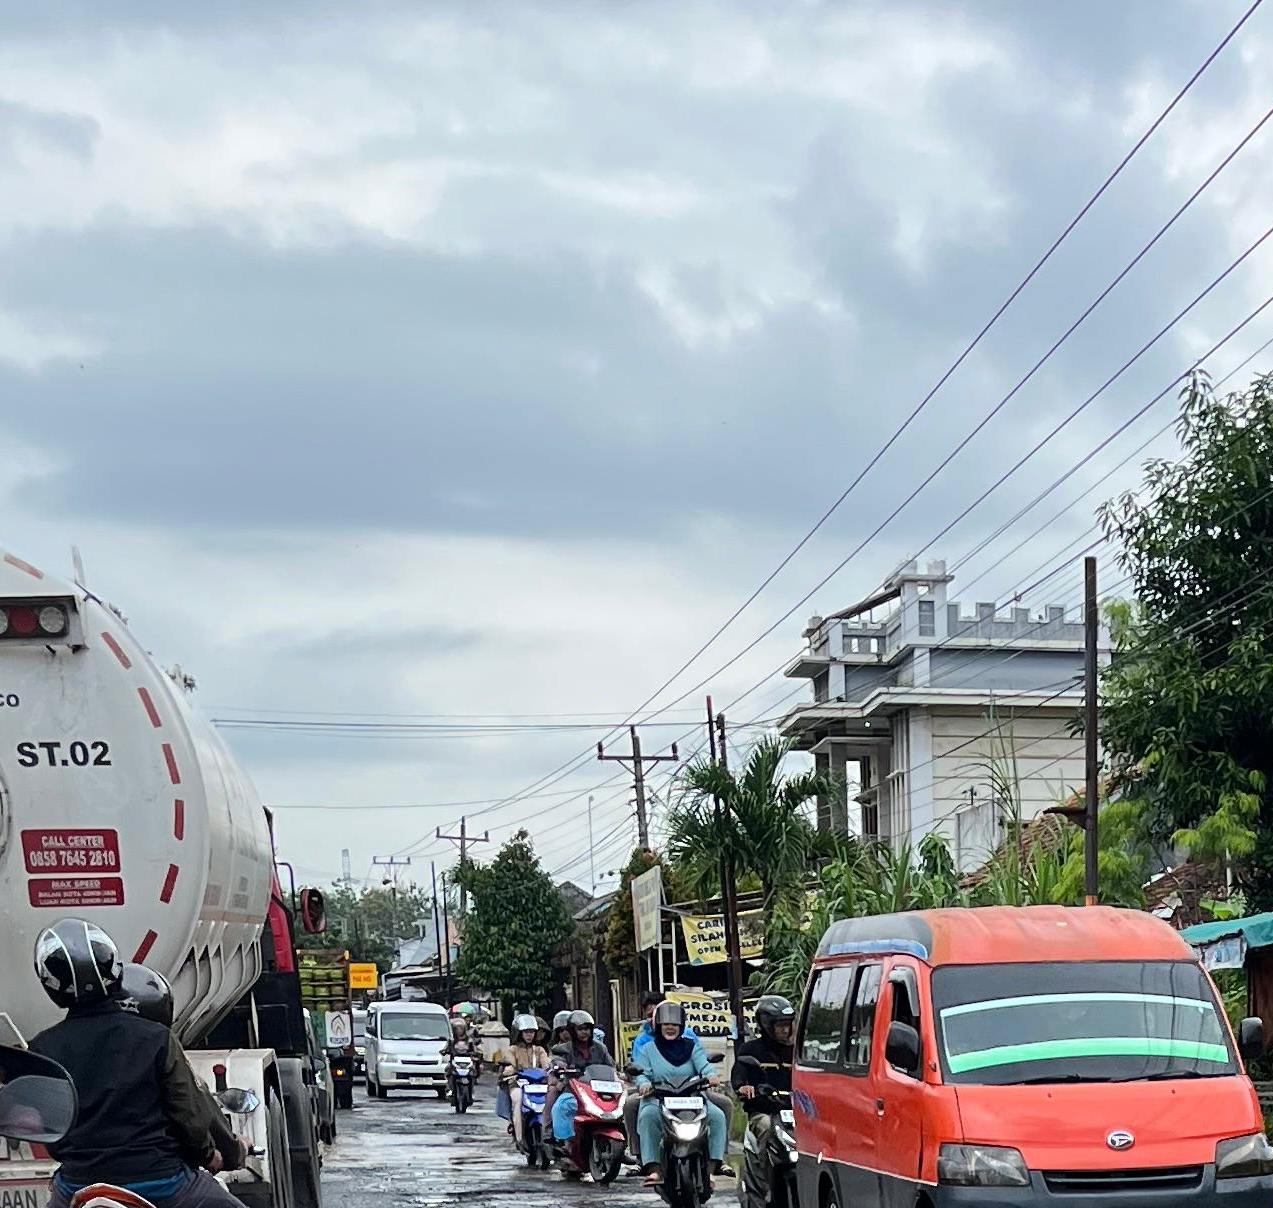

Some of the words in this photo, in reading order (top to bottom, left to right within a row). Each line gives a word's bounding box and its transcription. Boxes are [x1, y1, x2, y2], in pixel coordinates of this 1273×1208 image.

[17, 741, 112, 767] ST.02
[42, 835, 66, 848] CALL
[67, 835, 104, 848] CENTER
